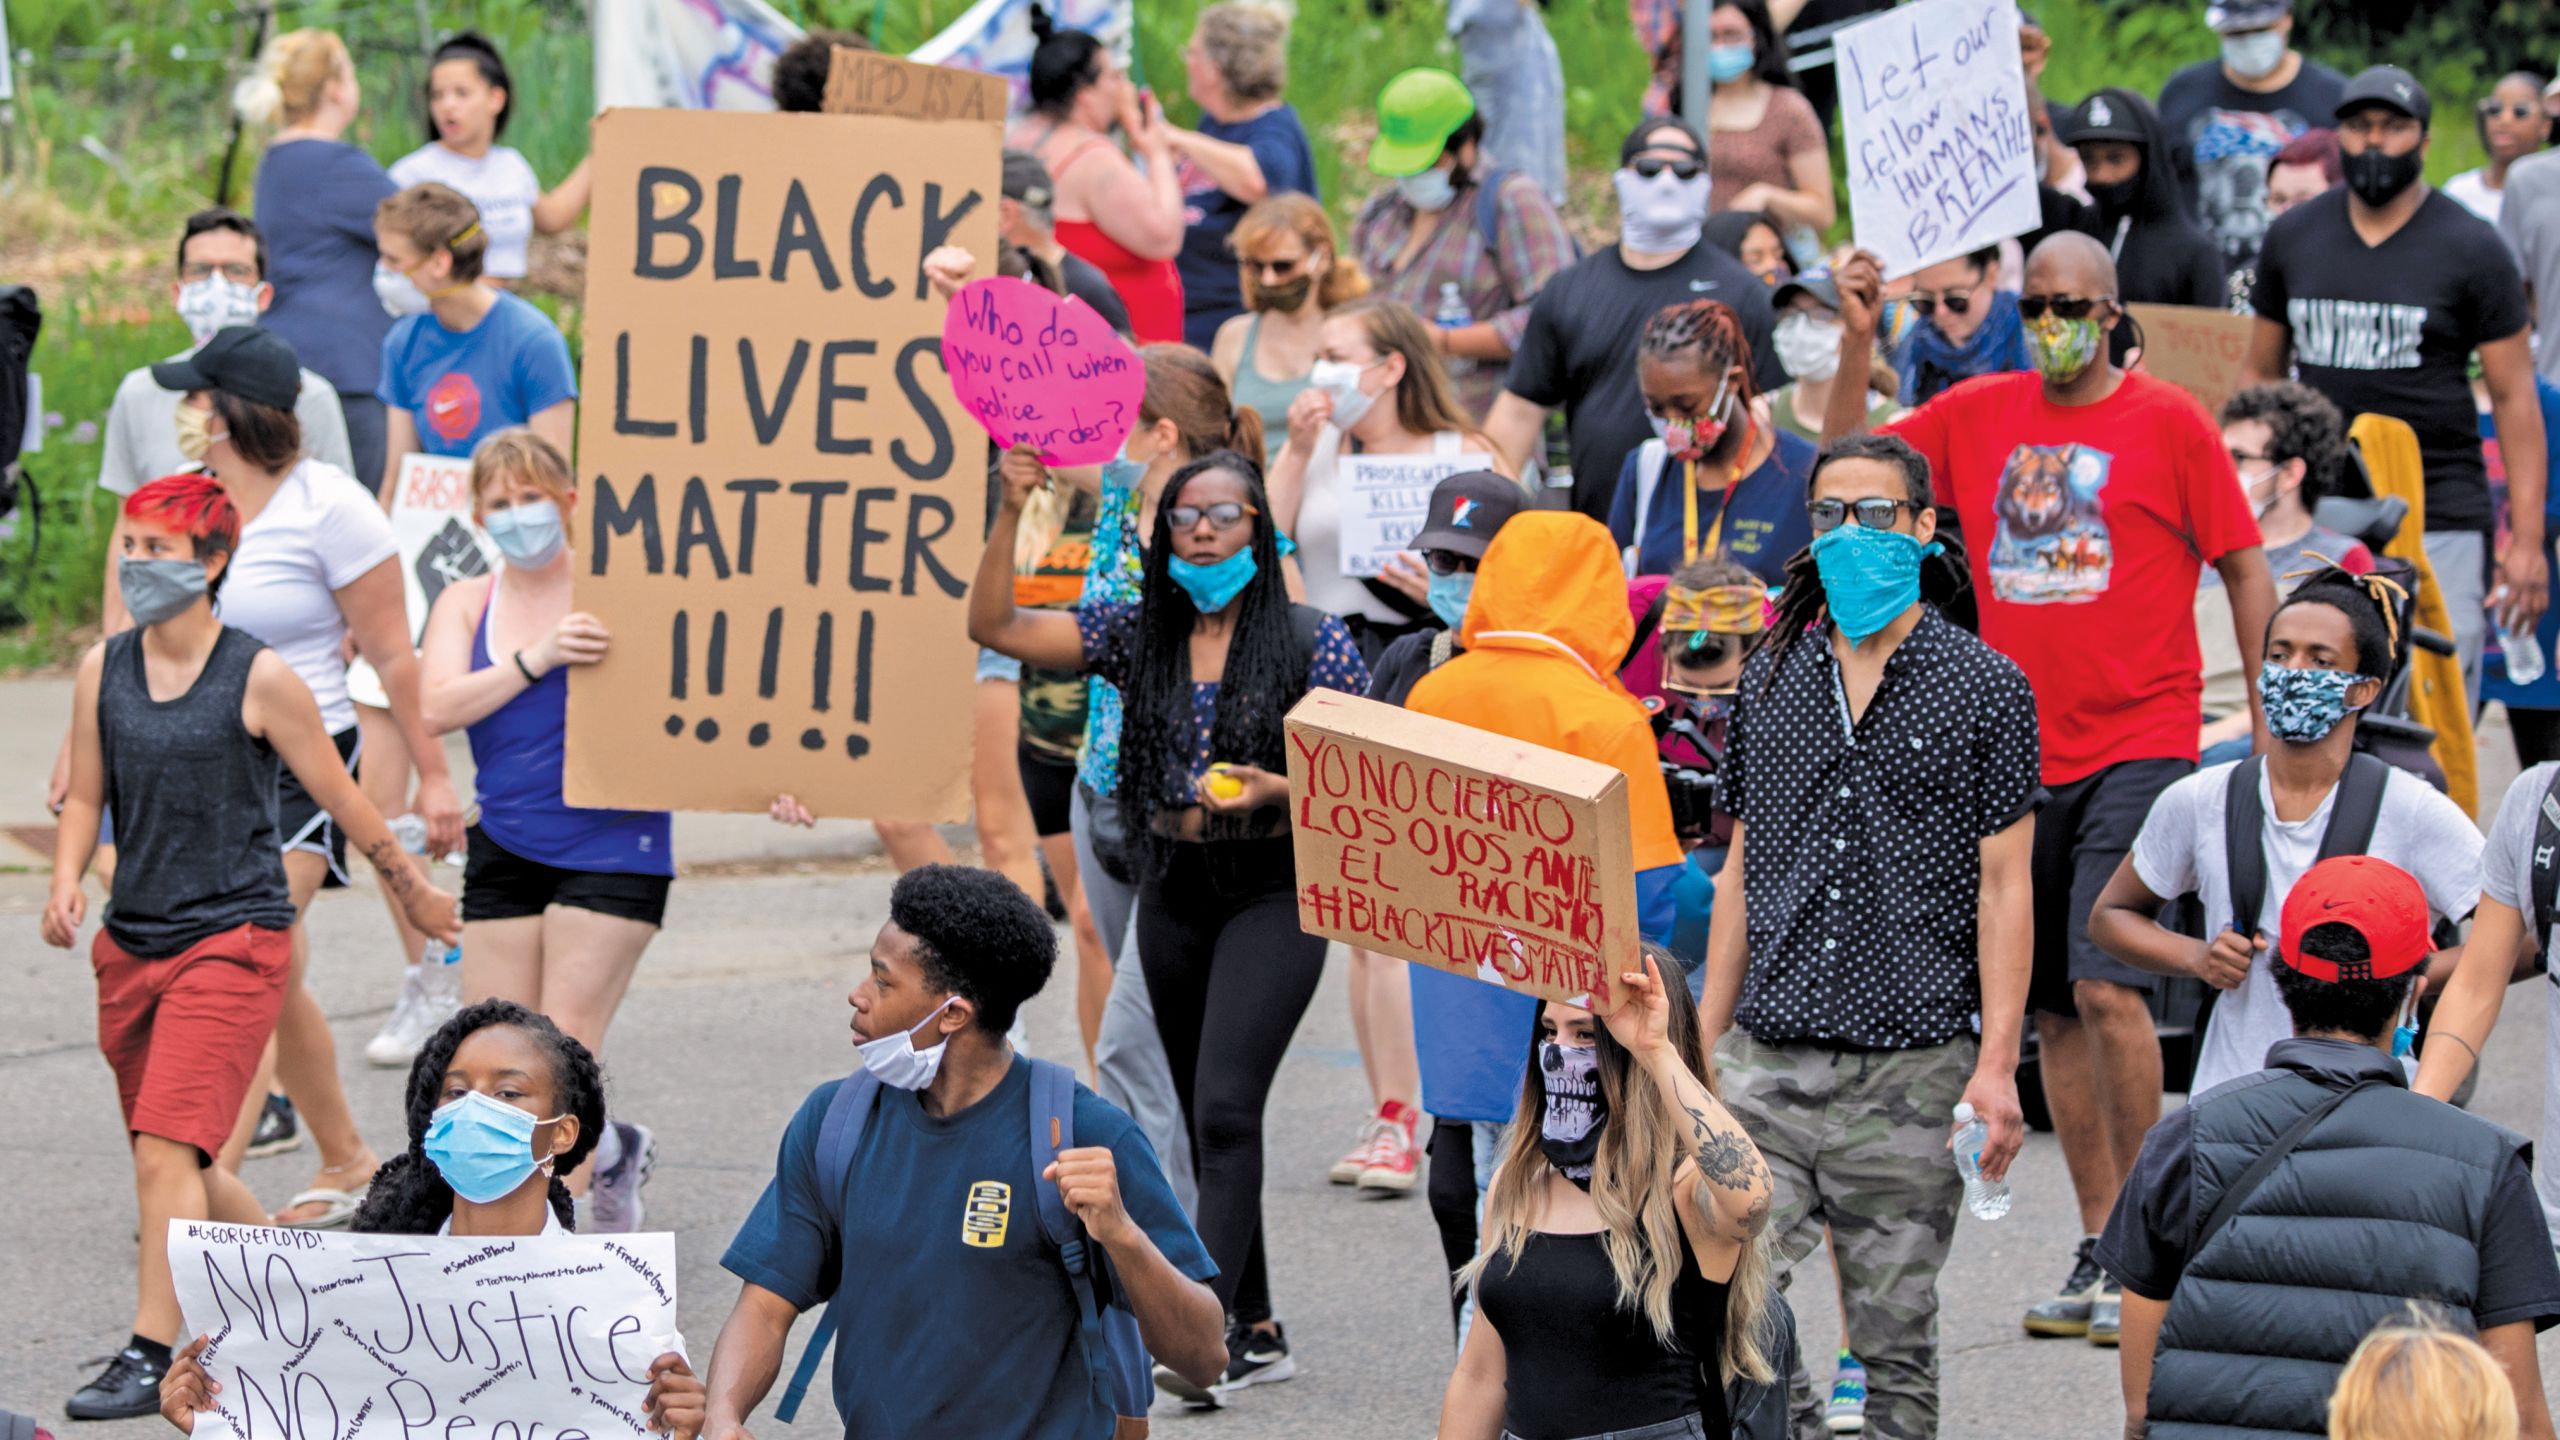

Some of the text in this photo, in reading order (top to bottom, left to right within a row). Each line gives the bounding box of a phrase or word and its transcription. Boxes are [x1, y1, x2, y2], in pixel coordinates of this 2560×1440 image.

[834, 55, 986, 122] MPD IS A
[1848, 5, 1998, 114] Let our
[1860, 100, 1942, 192] fellow
[1892, 87, 2009, 208] HUMANS
[1908, 110, 2031, 259] BREATHE
[633, 166, 983, 301] BLACK
[962, 287, 1079, 347] Who do
[613, 330, 956, 482] LIVES
[952, 345, 1128, 383] you call when
[975, 386, 1044, 424] police
[1012, 400, 1125, 447] murder?
[590, 473, 969, 600] MATTER
[1370, 490, 1431, 512] KILL
[1291, 732, 1575, 846] YO NO CIERRO
[1299, 796, 1397, 846] LOS
[1408, 817, 1513, 877] OJOS
[1339, 845, 1604, 953] EL RACISMO
[188, 1225, 326, 1251] #GEORGEFLOYD!
[202, 1244, 309, 1347] NO
[351, 1252, 658, 1386] Justice
[236, 1366, 340, 1440] NO
